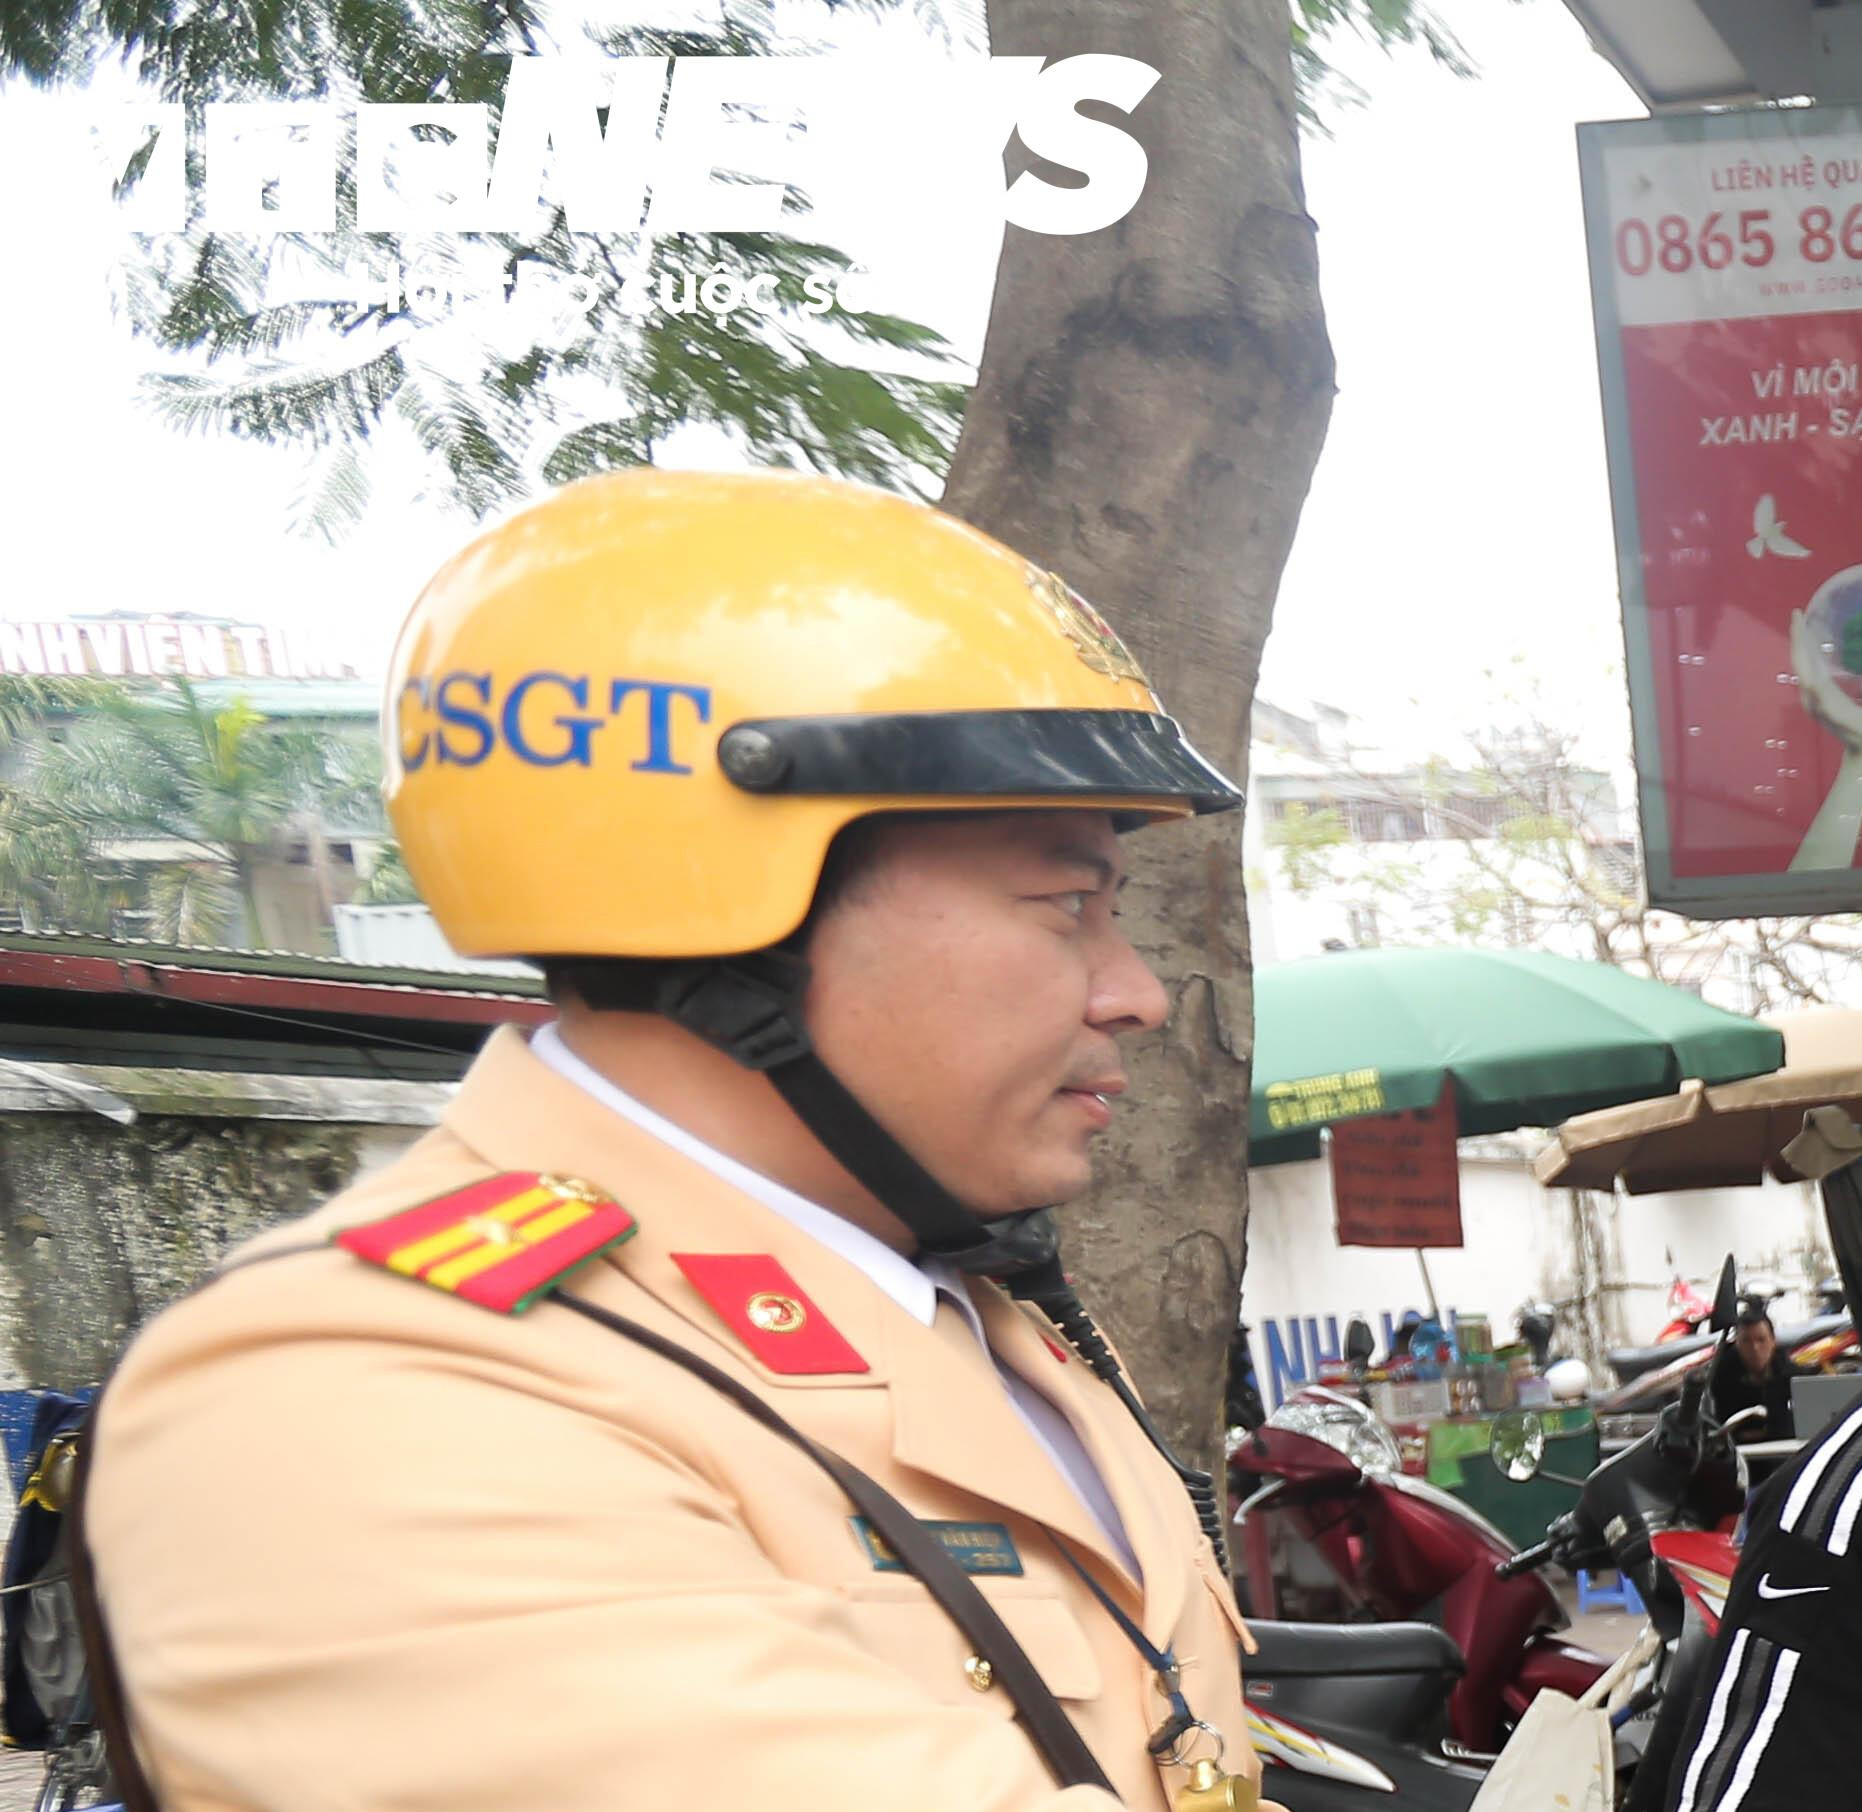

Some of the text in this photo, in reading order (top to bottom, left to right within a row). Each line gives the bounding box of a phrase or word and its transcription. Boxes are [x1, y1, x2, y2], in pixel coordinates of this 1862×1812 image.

[1711, 159, 1773, 192] LIÊN
[1780, 154, 1815, 191] HỆ
[1615, 208, 1775, 277] 0865
[1751, 361, 1785, 398] VÌ
[1793, 358, 1858, 397] MÔI
[1699, 412, 1798, 446] XANH
[398, 670, 712, 776] CSGT
